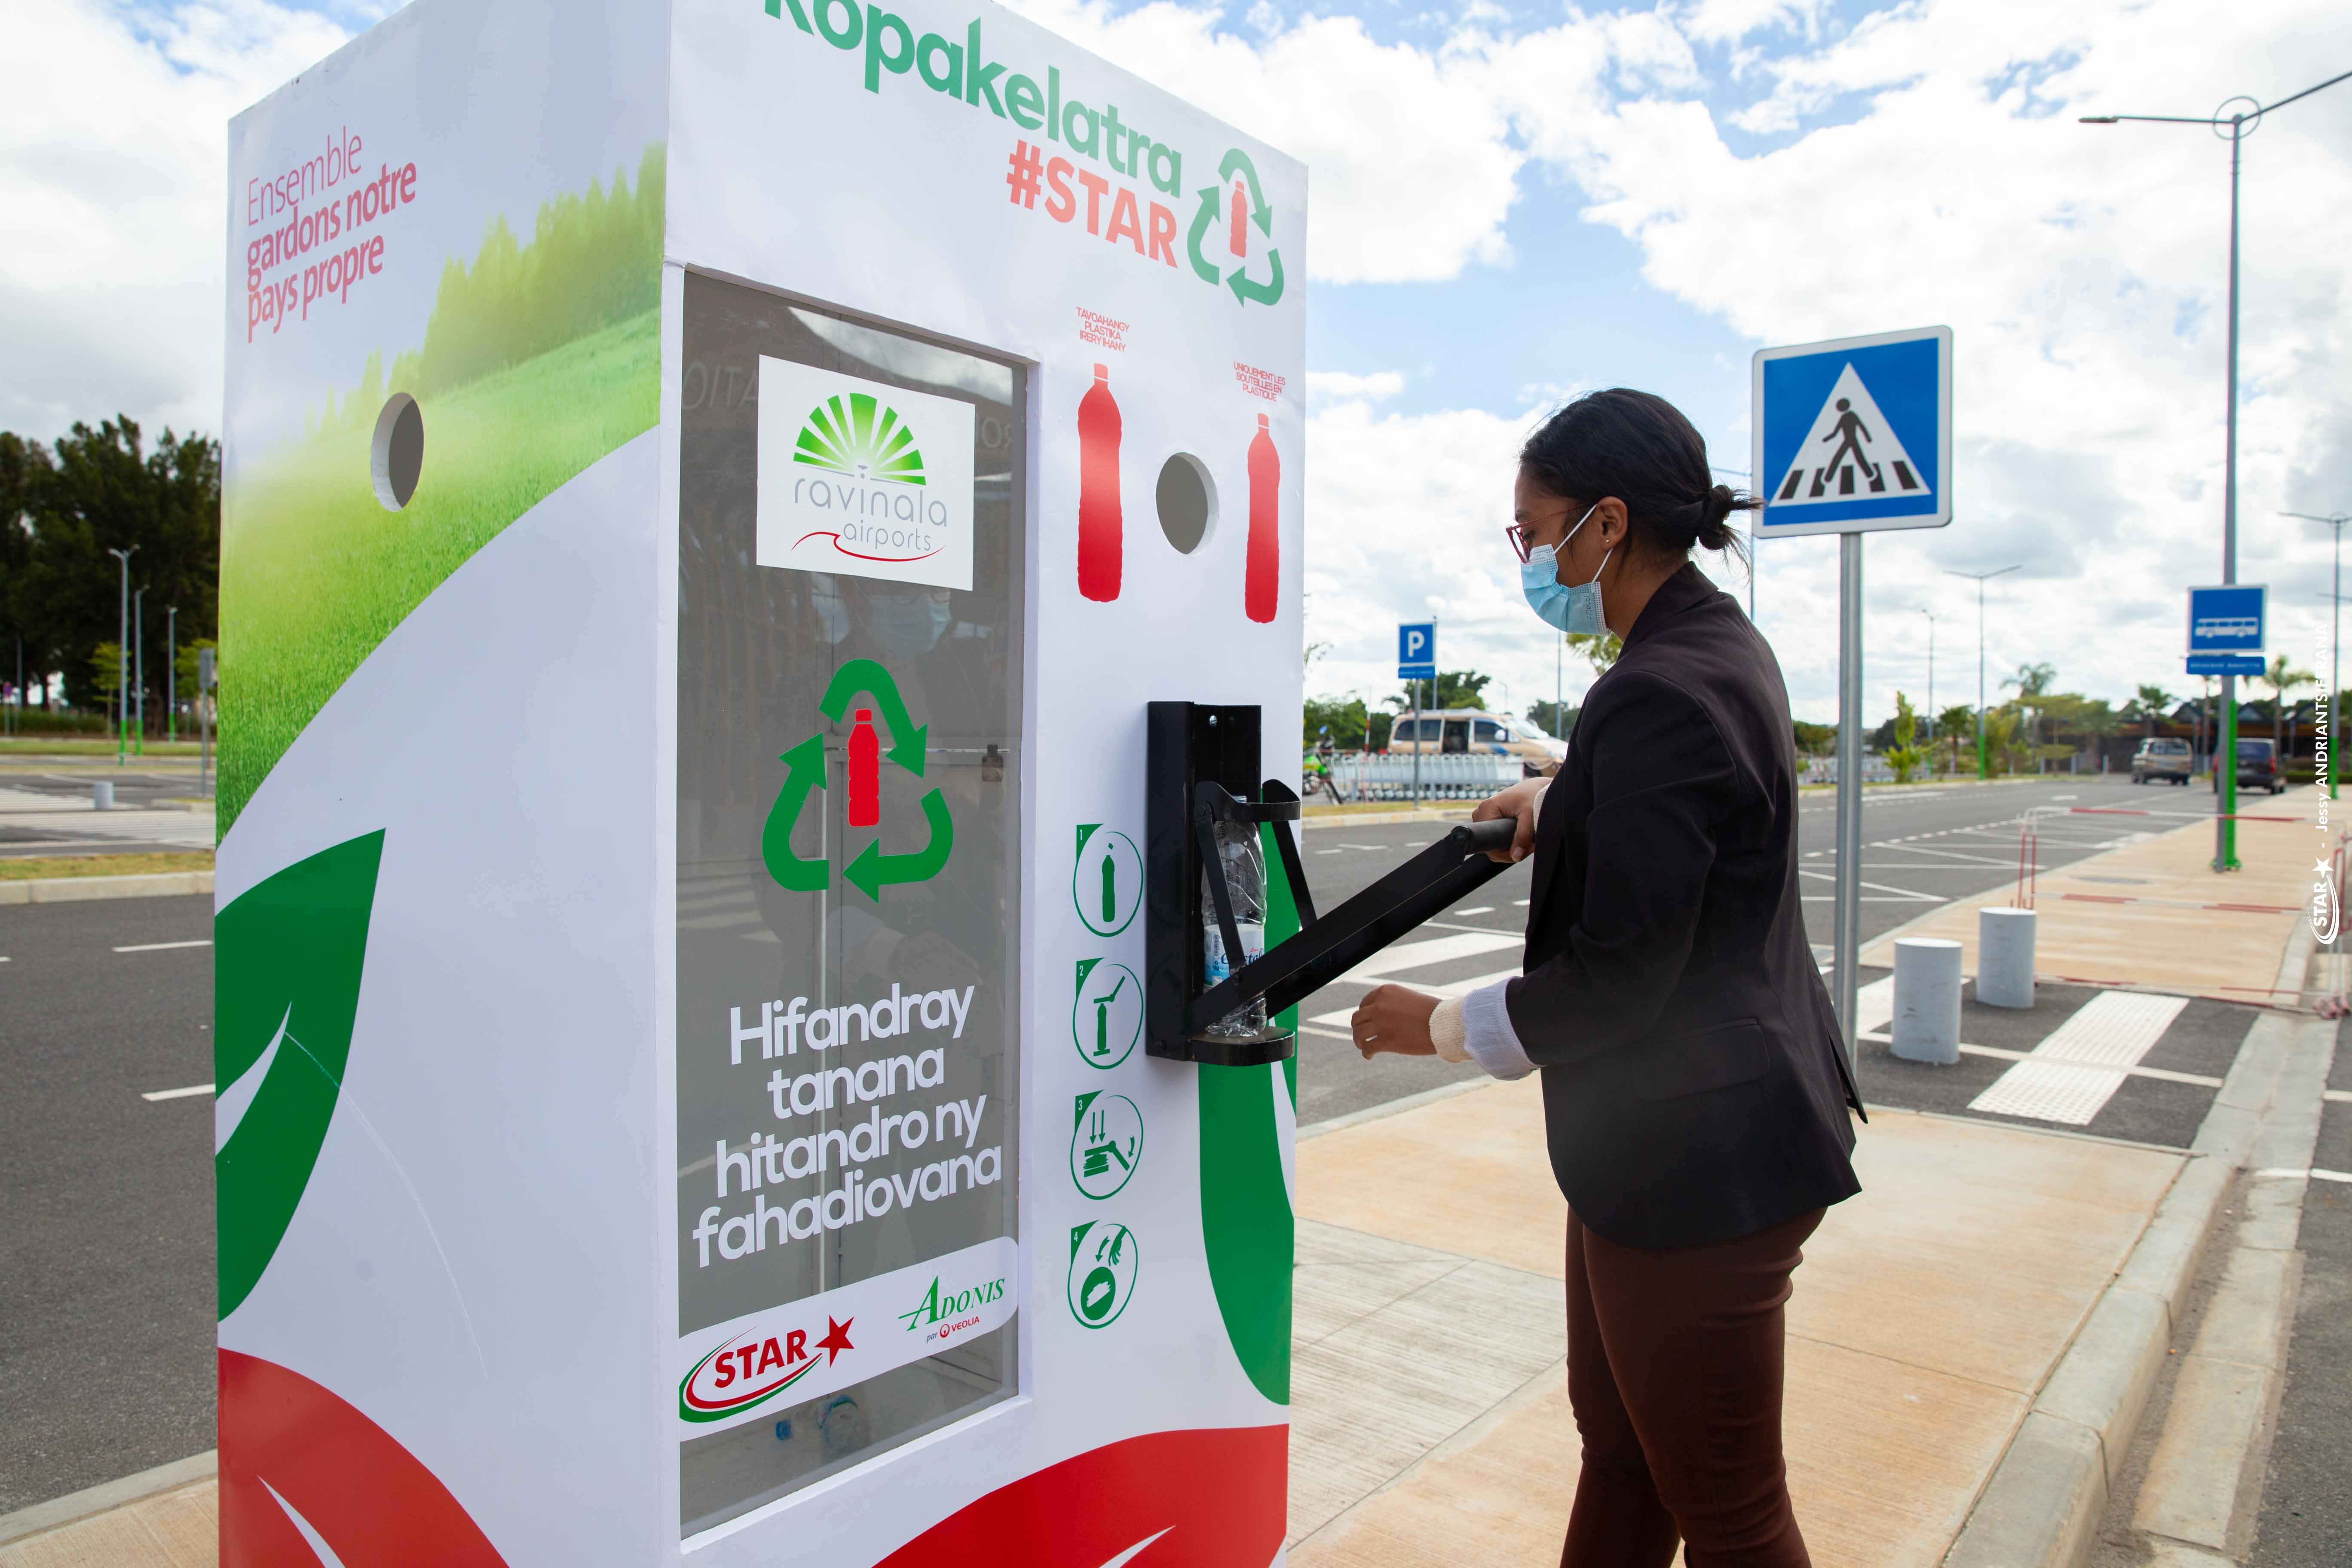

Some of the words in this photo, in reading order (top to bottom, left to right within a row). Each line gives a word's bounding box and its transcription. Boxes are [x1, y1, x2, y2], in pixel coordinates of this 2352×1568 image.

[248, 126, 363, 227] Ensemble
[1006, 140, 1178, 269] #STAR
[247, 206, 340, 292] gardons
[346, 162, 417, 233] notre
[248, 273, 298, 344] pays
[302, 235, 385, 322] propre
[1076, 306, 1130, 333] TAVOAHANGY
[1084, 320, 1121, 341] PLASTIKA
[1080, 330, 1101, 346] IRERY
[1102, 337, 1126, 352] IHANY
[1233, 361, 1274, 382] UNIQUEMENT
[1274, 374, 1286, 386] LES
[1236, 371, 1273, 392] BOUTEILLES
[1274, 384, 1282, 395] EN
[1242, 383, 1277, 402] PLASTIQUE
[794, 478, 947, 527] ravinala
[843, 523, 931, 551] airports
[1408, 631, 1424, 657] P
[1079, 829, 1083, 840] 1
[1079, 965, 1084, 976] 2
[730, 983, 975, 1065] Hifandray
[767, 1047, 944, 1119] tanana
[1078, 1099, 1083, 1111] 3
[717, 1105, 929, 1198] hitandro
[936, 1095, 987, 1148] ny
[692, 1146, 1001, 1268] fahadiovana
[1074, 1231, 1078, 1242] 4
[926, 1332, 938, 1344] par
[951, 1316, 980, 1332] VEOLIA
[714, 1329, 807, 1389] STAR
